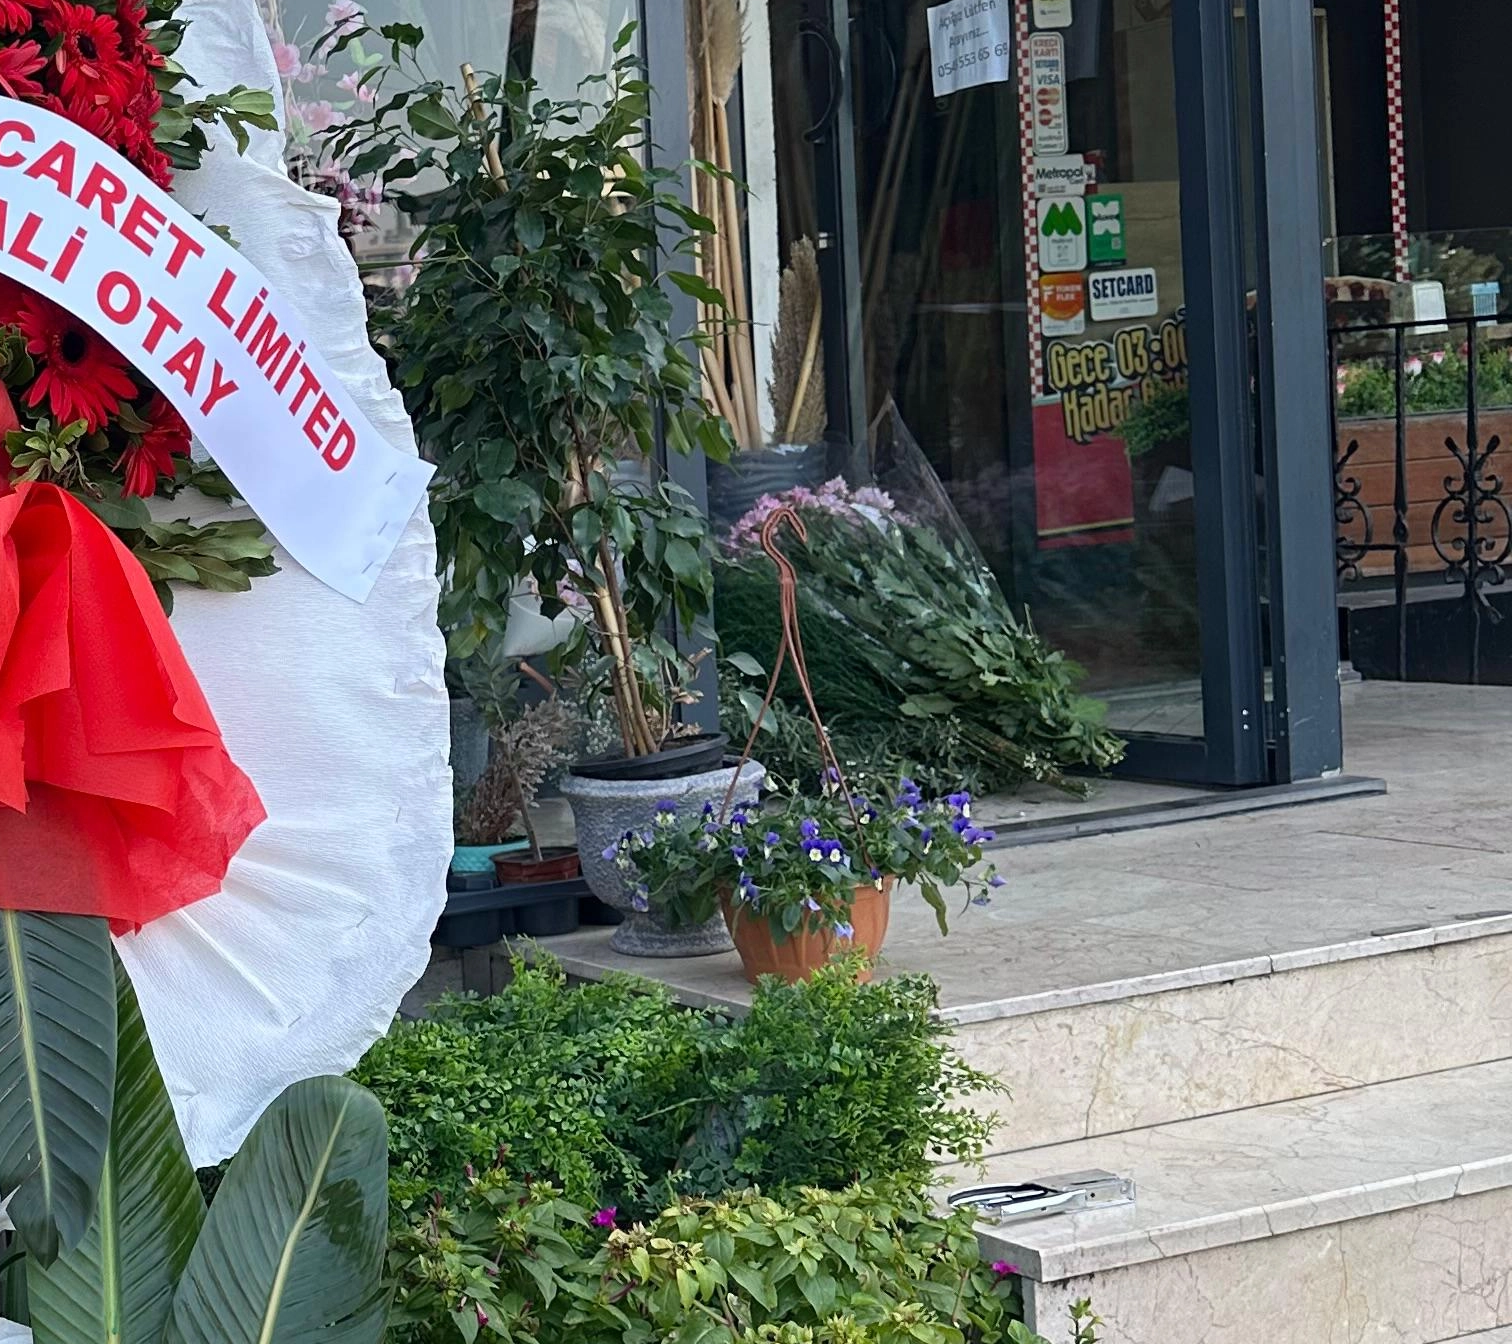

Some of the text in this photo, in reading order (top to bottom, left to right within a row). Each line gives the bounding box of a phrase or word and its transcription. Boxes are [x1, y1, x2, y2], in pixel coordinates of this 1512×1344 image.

[1036, 74, 1061, 85] VISA
[1036, 166, 1084, 180] Metropol
[1092, 274, 1154, 299] SETCARD
[96, 271, 239, 416] OTAY
[207, 269, 357, 472] LİMİTED
[1049, 342, 1111, 389] Gece
